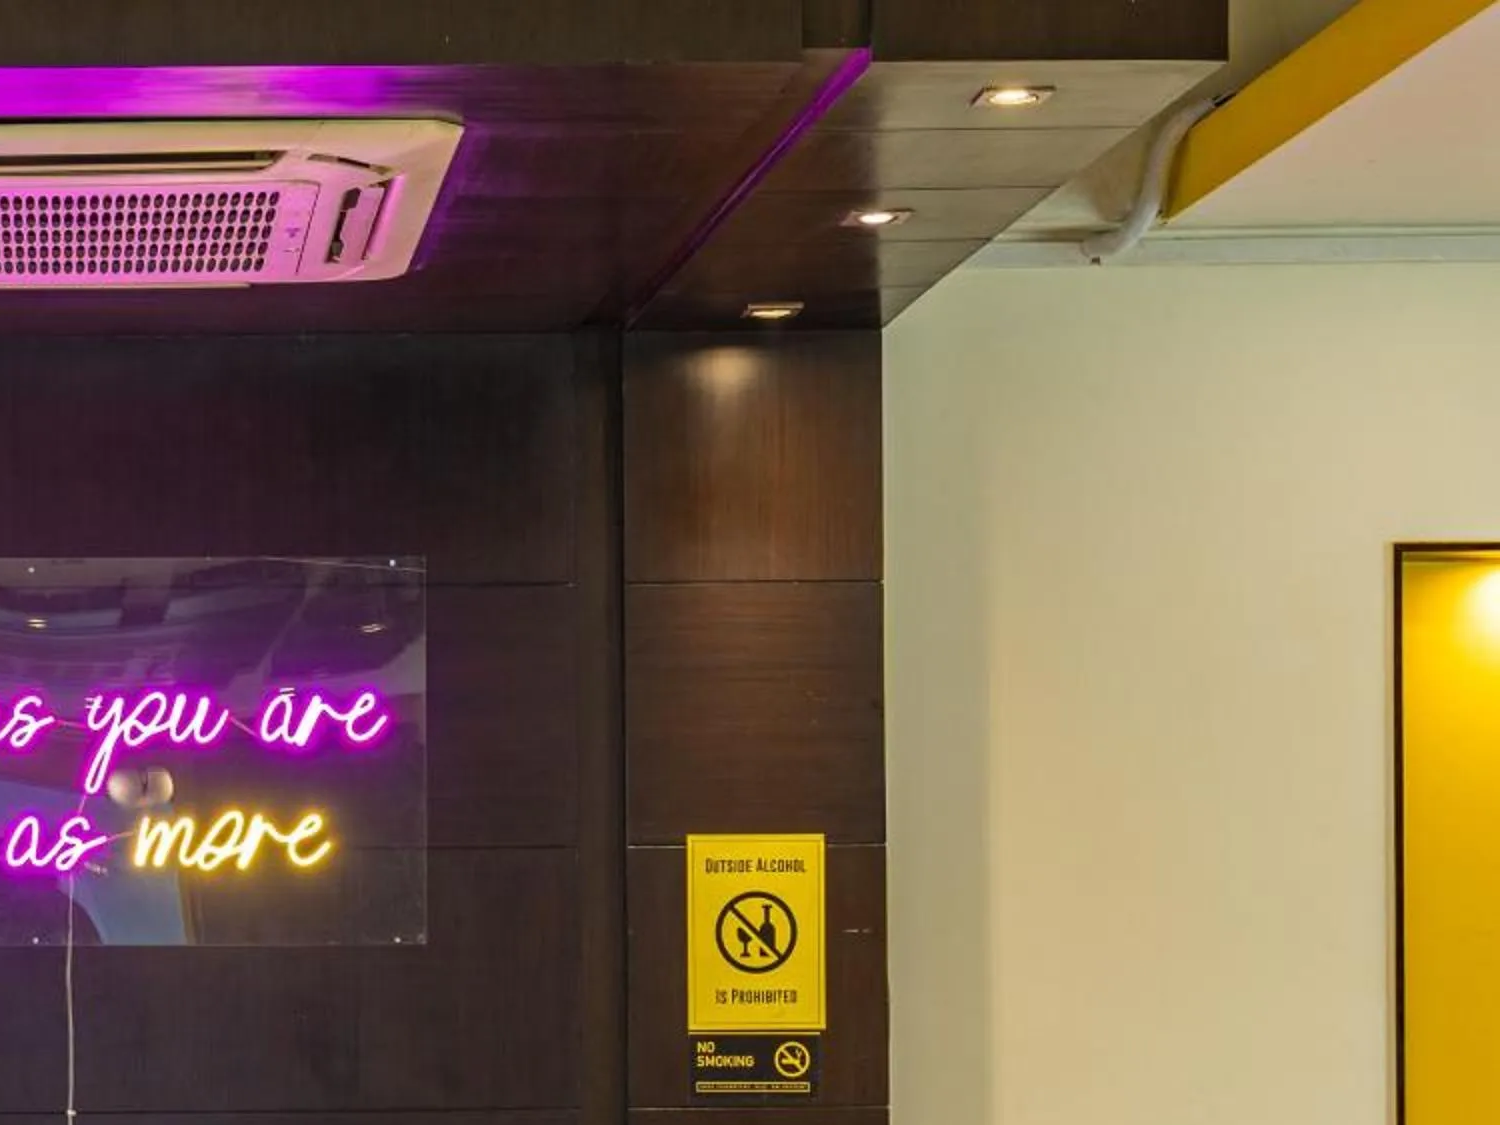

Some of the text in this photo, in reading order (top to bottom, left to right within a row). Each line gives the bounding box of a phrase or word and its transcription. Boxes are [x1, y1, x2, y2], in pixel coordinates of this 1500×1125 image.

[84, 690, 231, 795] you
[258, 687, 389, 745] are
[4, 812, 108, 872] as
[132, 809, 333, 872] more
[696, 1041, 716, 1054] NO
[696, 1055, 755, 1068] SMOKING
